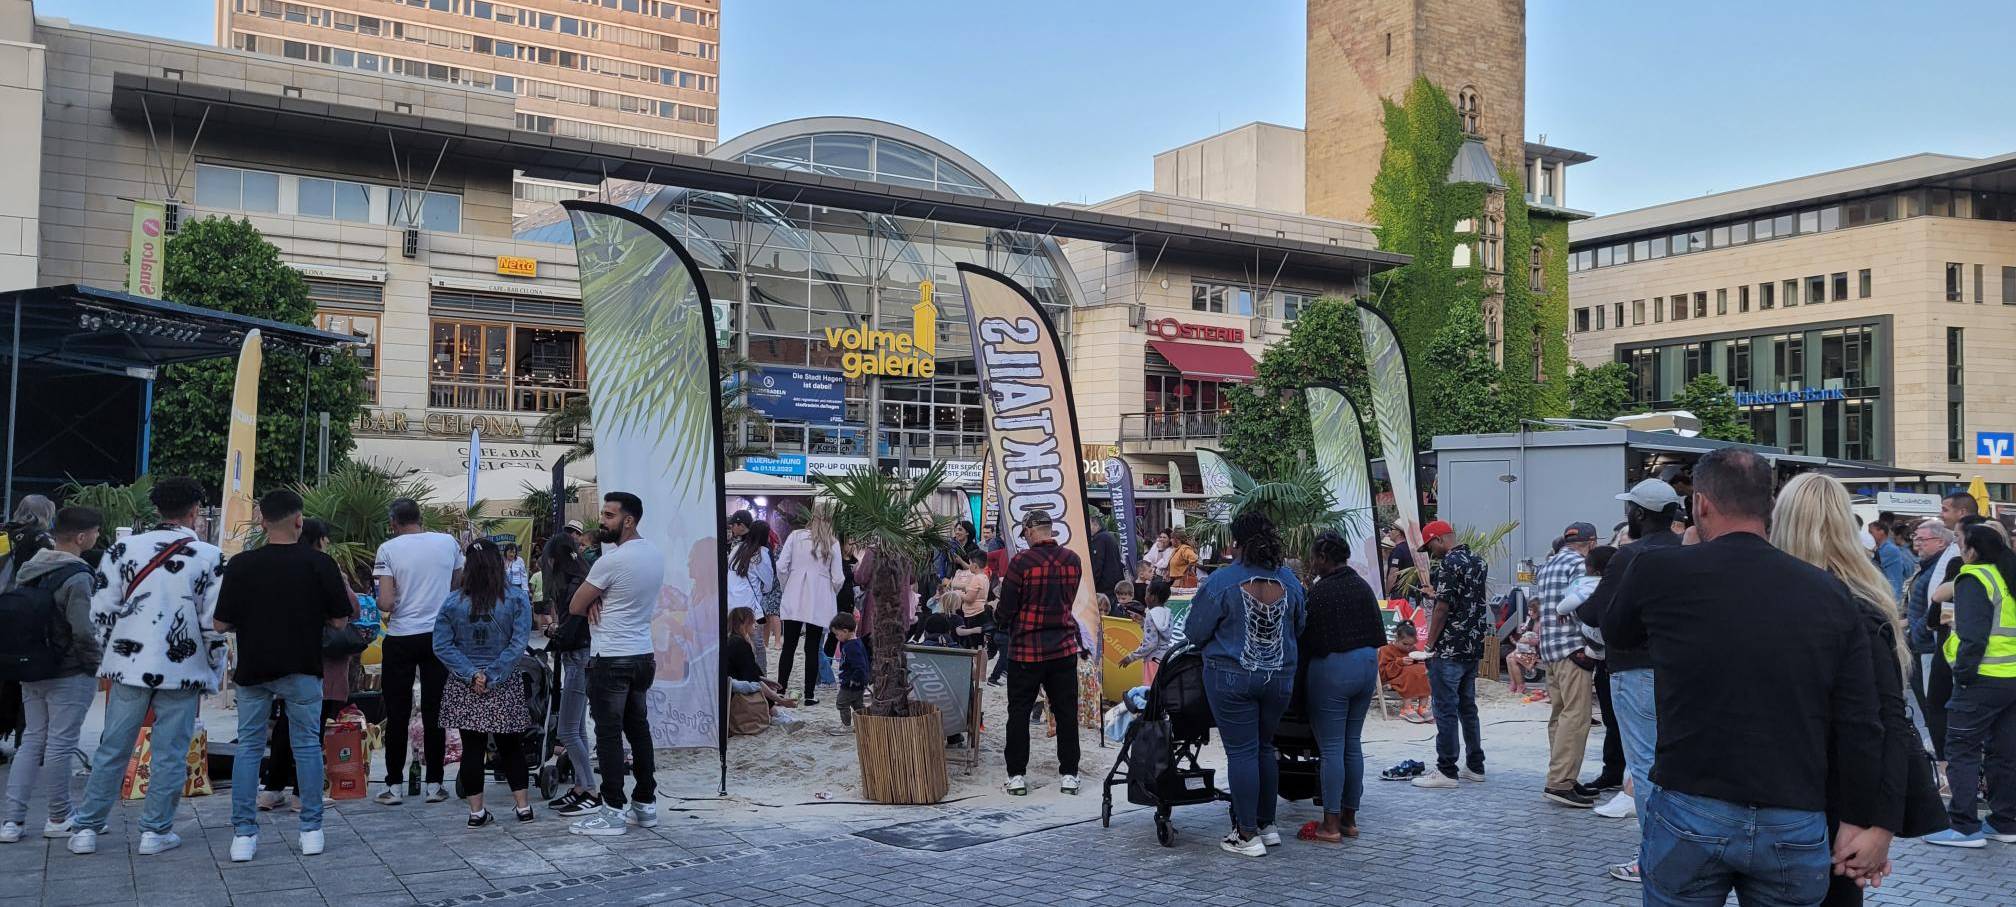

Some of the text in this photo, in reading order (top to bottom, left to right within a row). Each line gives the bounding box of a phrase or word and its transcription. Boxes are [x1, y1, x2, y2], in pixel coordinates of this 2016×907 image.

[500, 257, 535, 271] Netto
[825, 321, 913, 353] volme
[842, 348, 936, 379] galerie
[792, 372, 843, 384] Die Stadt Hagen
[1804, 384, 1847, 400] Bank
[358, 412, 525, 437] BAR CELONA
[824, 437, 846, 445] Hagn
[457, 447, 498, 457] CFE
[509, 449, 542, 458] BAR
[808, 462, 839, 470] POP-UP
[892, 466, 930, 478] STURN
